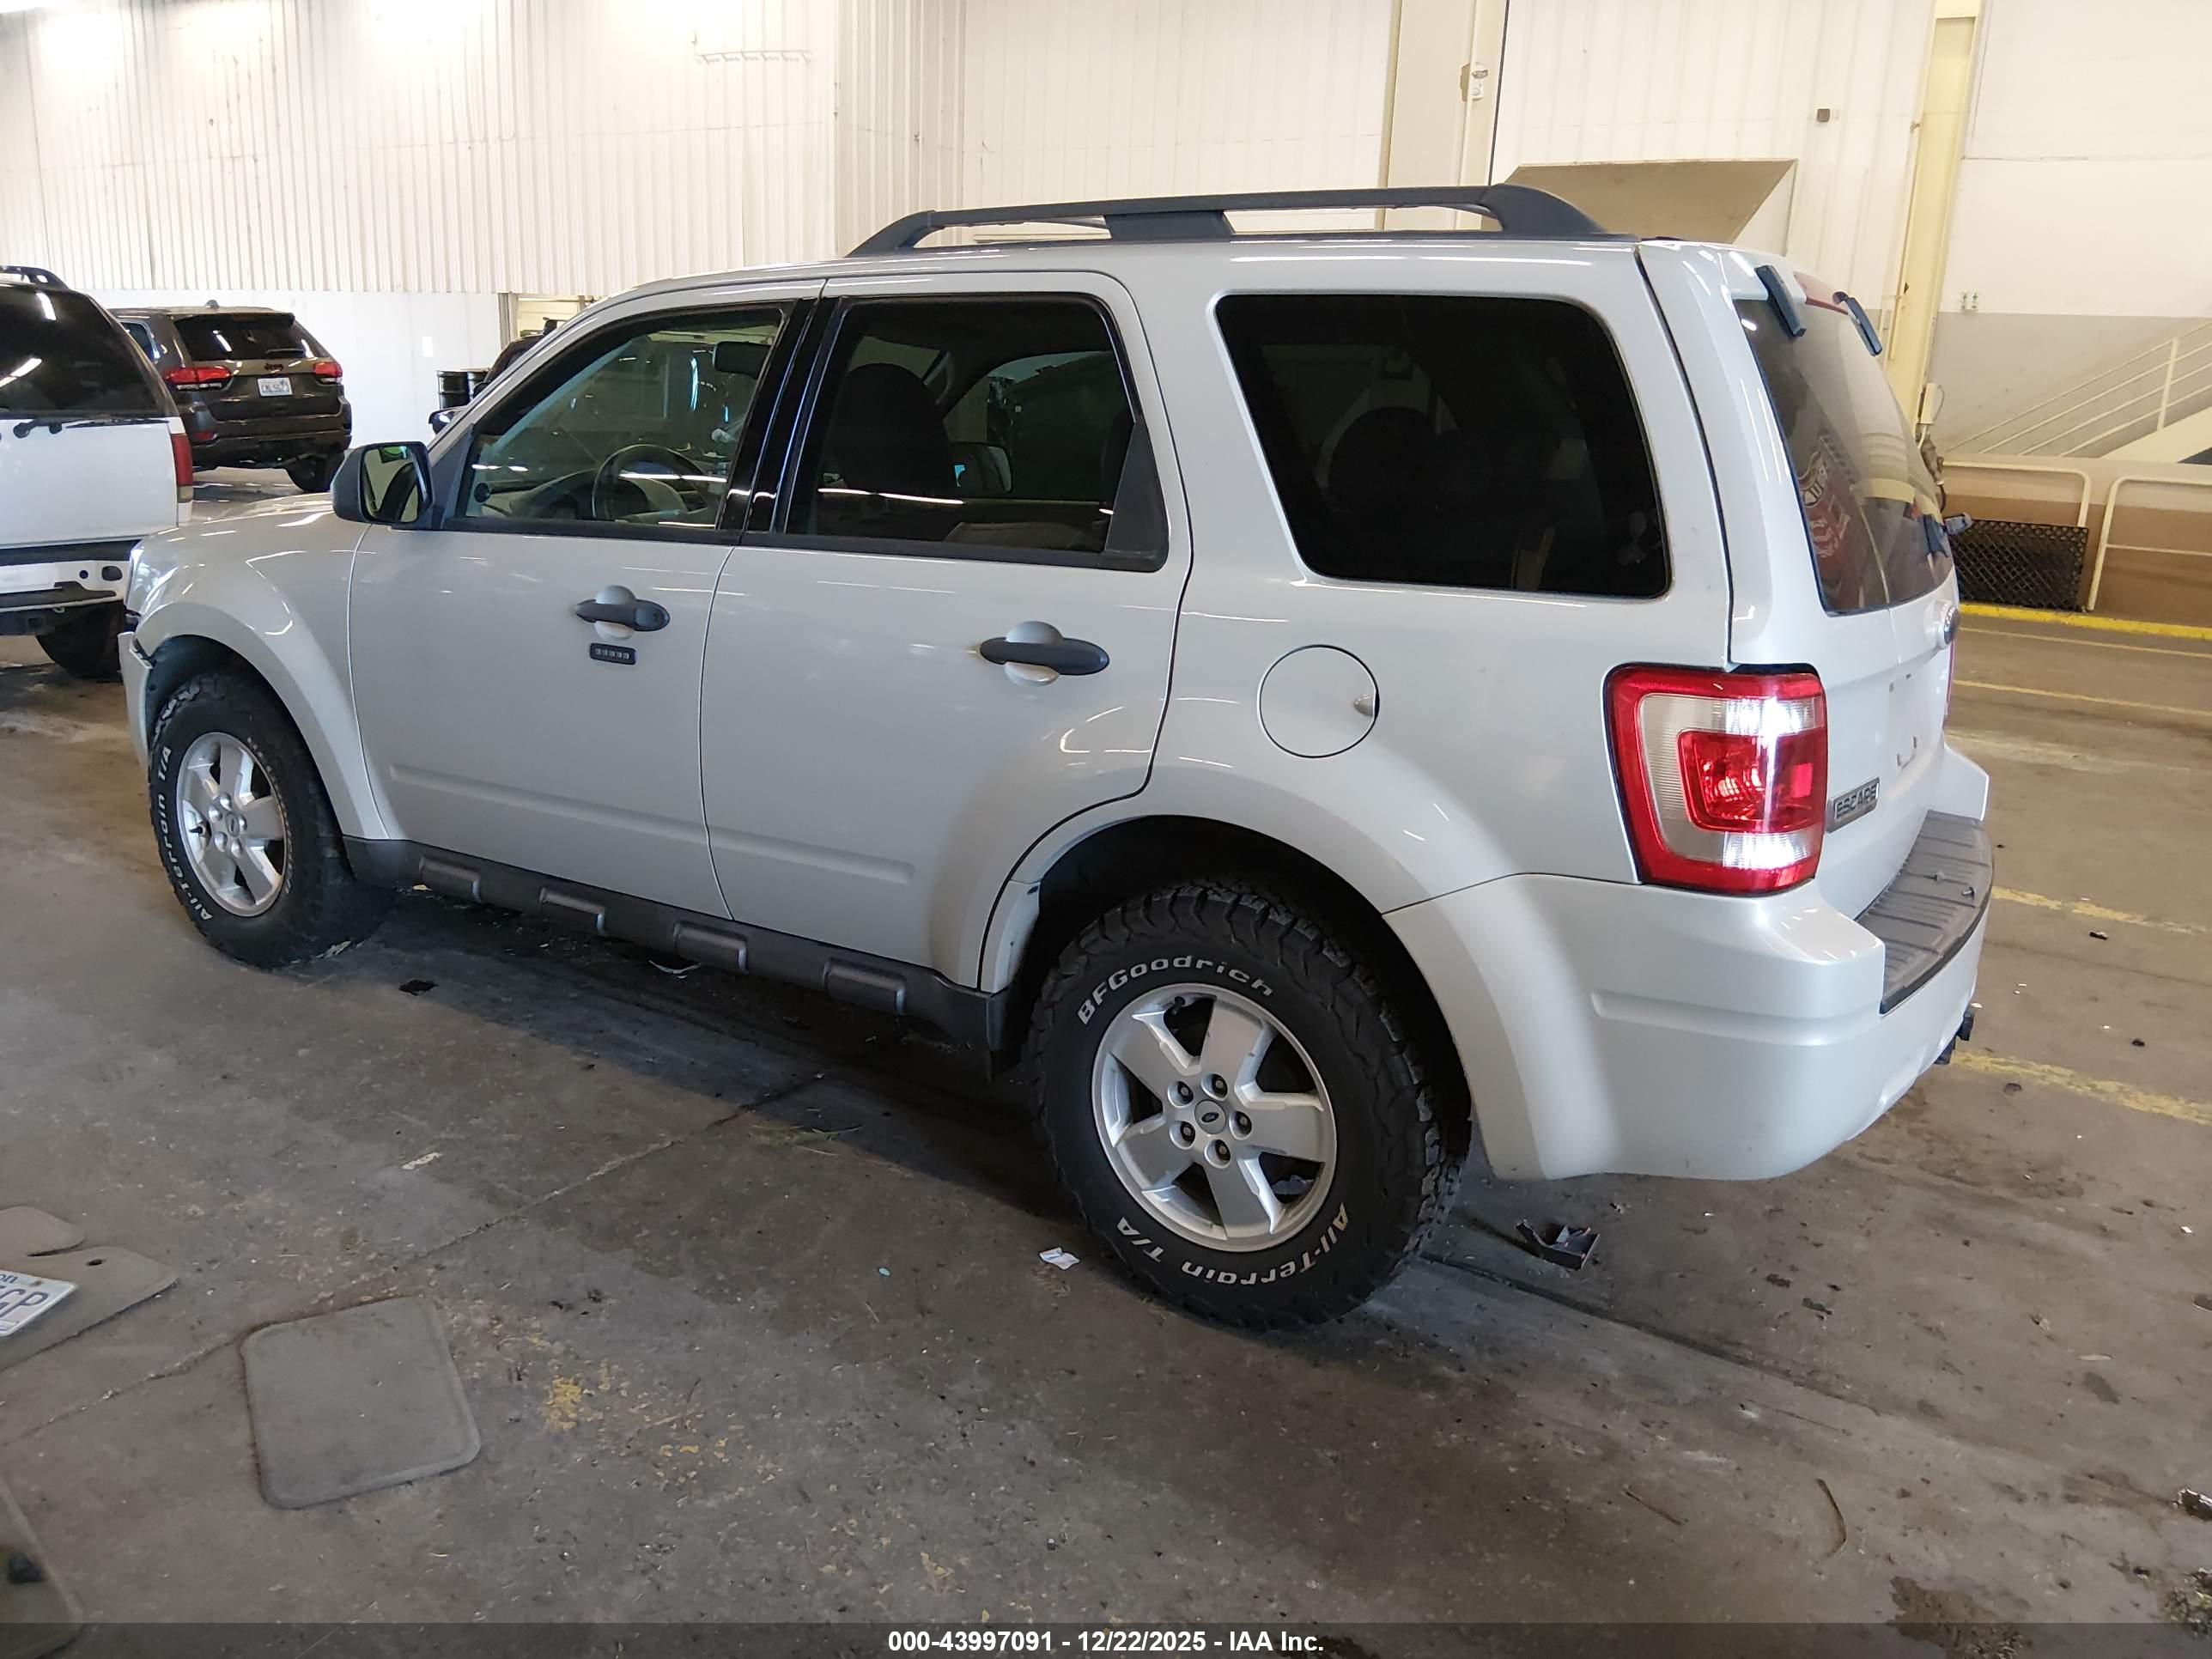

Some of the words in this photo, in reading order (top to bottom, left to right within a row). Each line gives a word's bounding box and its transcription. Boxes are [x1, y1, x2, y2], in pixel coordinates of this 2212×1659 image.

[158, 746, 172, 781] T/A
[1835, 784, 1878, 819] ESCAPE
[157, 793, 213, 921] All-Terrain
[1077, 956, 1274, 1025] BFGoodrich
[1116, 1217, 1164, 1262] T/A
[1182, 1202, 1349, 1285] All-Terrain
